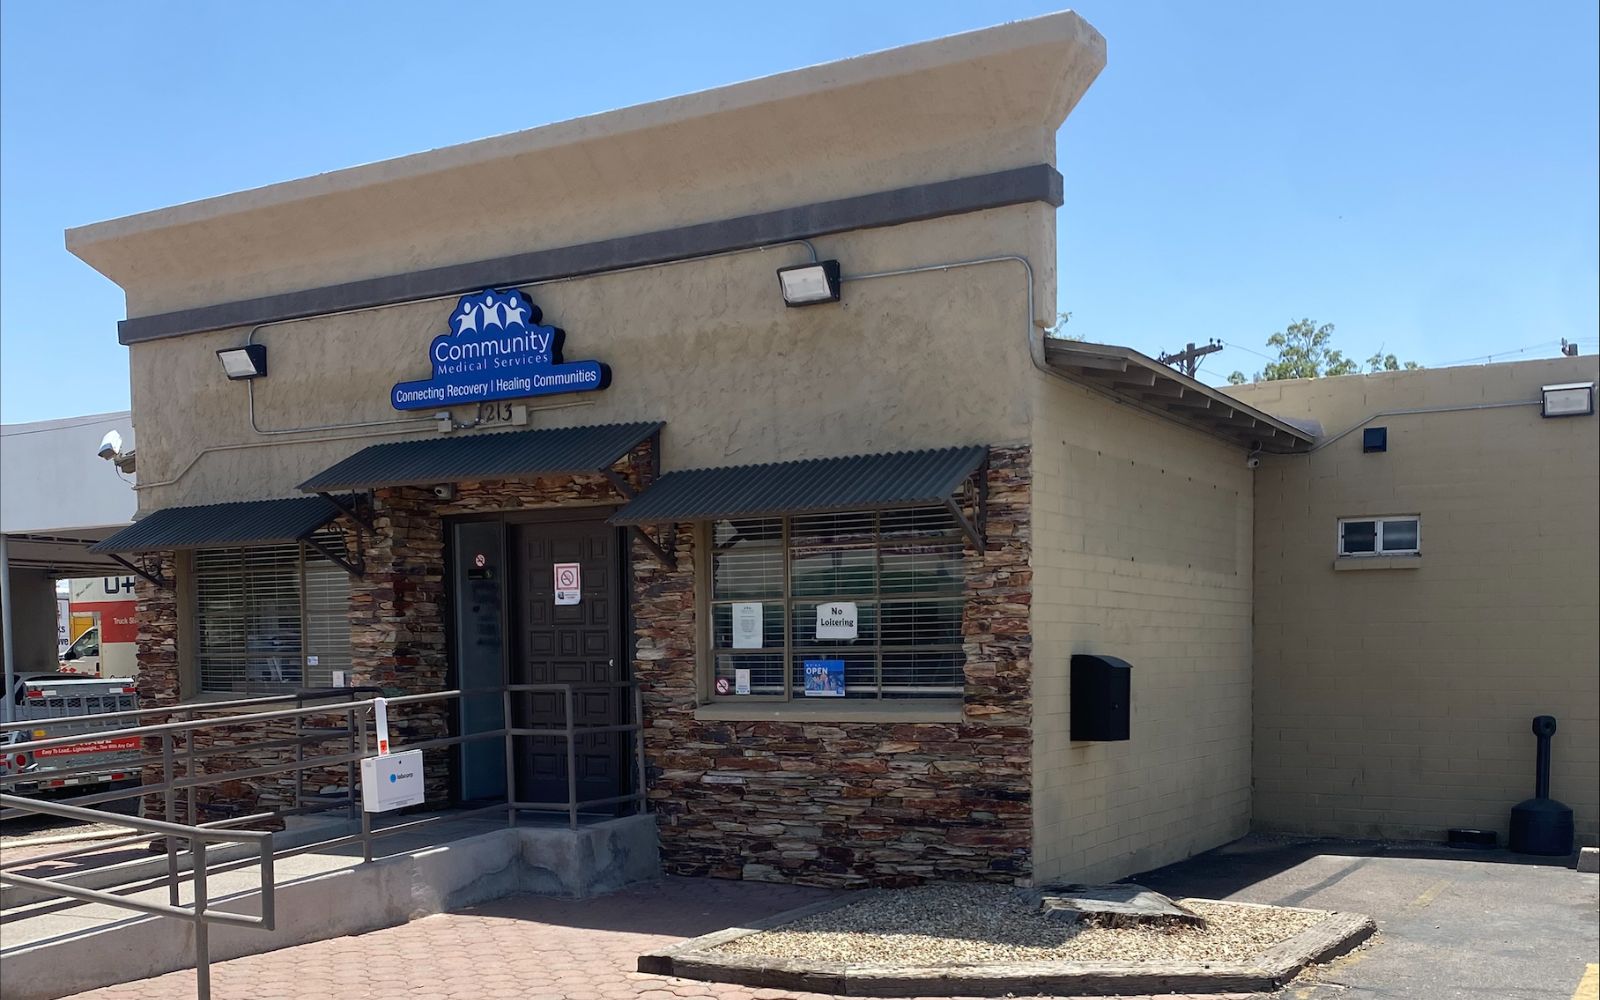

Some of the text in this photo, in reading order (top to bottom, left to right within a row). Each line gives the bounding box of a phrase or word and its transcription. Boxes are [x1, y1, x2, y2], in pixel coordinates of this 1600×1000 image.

[435, 331, 550, 362] Community
[438, 353, 549, 375] Medical Services
[396, 386, 445, 403] Connecting
[446, 383, 488, 397] Recovery
[496, 377, 531, 391] Healing
[533, 370, 597, 388] Communities
[831, 607, 843, 615] No
[820, 617, 854, 628] Loitering
[805, 667, 829, 675] OPEN
